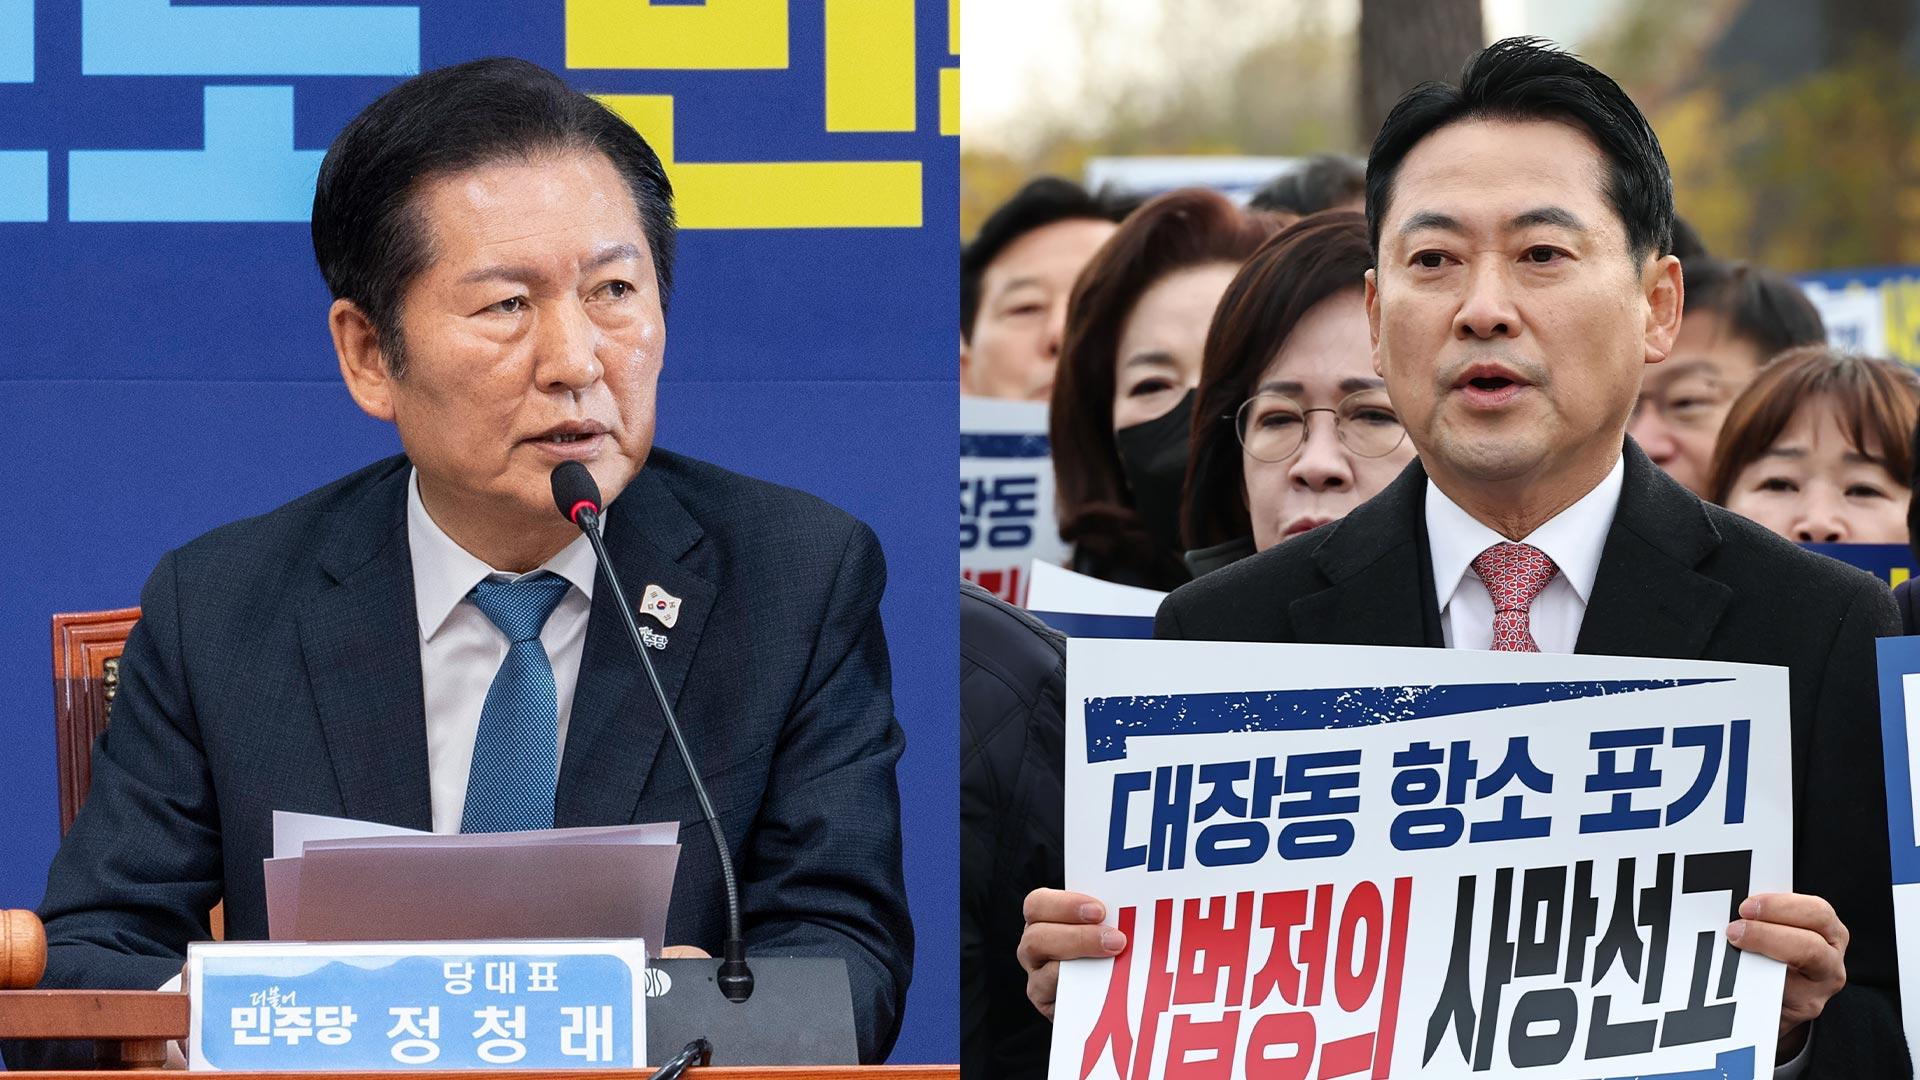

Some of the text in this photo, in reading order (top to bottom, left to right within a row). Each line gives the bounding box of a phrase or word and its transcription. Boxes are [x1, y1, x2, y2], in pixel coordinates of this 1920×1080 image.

[1105, 719, 1752, 872] 대장동 항소 포기
[443, 961, 560, 994] 당대표
[1079, 850, 1753, 1080] 사법정의 사망선고
[249, 985, 297, 1009] 더불어
[231, 1005, 358, 1046] 민주당
[386, 1005, 614, 1064] 정청래
